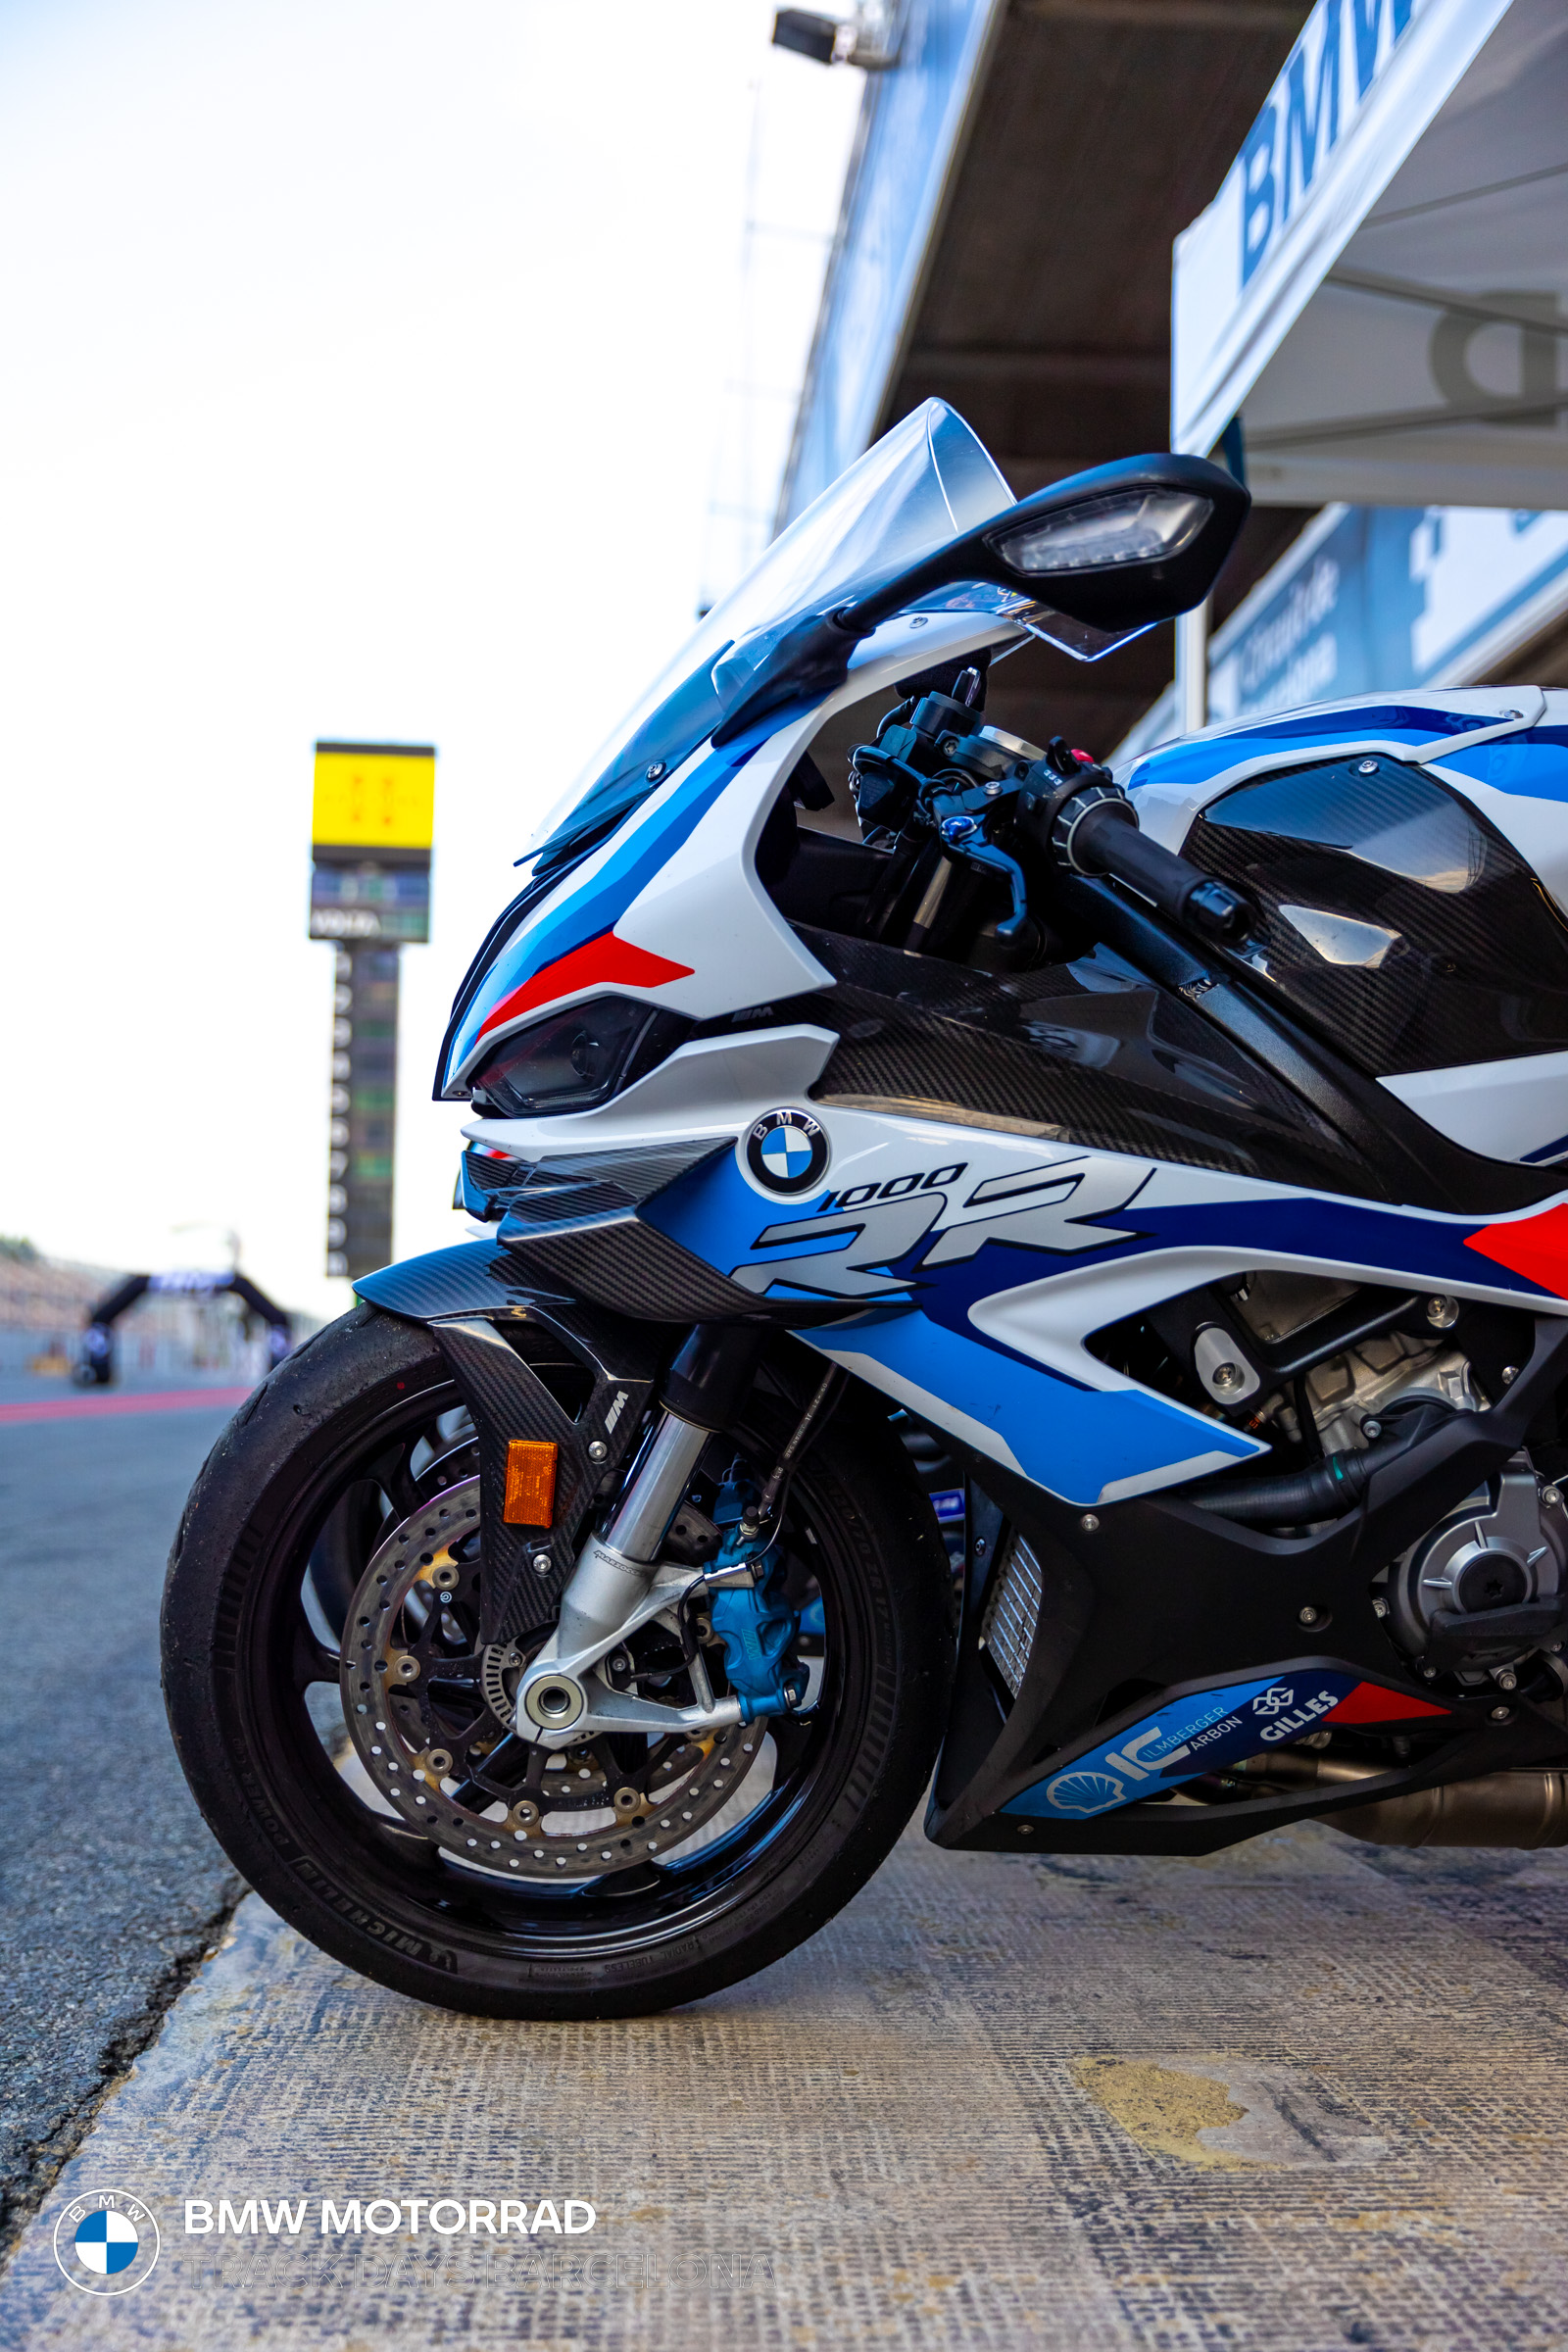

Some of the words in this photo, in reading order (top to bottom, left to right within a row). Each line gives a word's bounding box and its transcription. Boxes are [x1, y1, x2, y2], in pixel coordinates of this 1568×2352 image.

[1241, 0, 1414, 290] BMW
[753, 1111, 821, 1142] BMW
[816, 1161, 969, 1213] 1000
[1143, 1706, 1229, 1759] ILMBERGER
[1260, 1690, 1339, 1741] GILLES
[296, 1862, 423, 1957] MICHELIN
